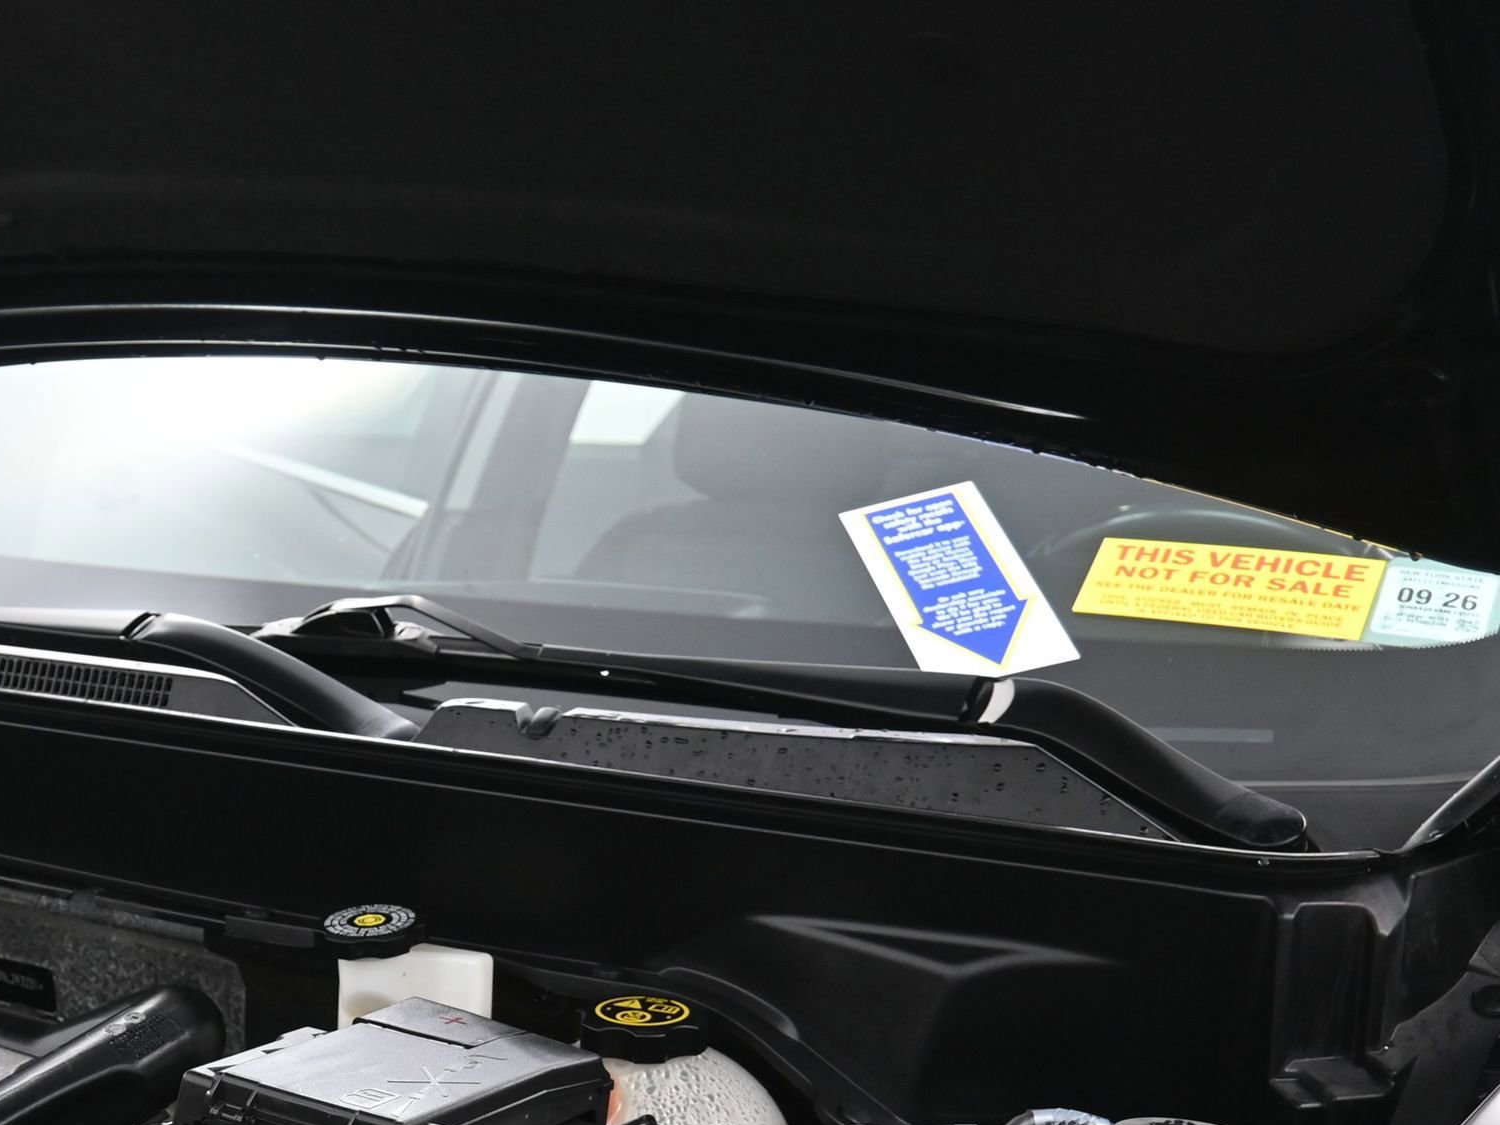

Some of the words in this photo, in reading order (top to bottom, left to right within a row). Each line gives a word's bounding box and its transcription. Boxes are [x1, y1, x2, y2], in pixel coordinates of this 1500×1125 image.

[1117, 545, 1195, 566] THIS
[1210, 551, 1370, 582] VEHICLE
[1115, 565, 1179, 580] NOT
[1189, 570, 1255, 588] FOR
[1266, 577, 1354, 599] SALE
[1127, 583, 1154, 591] THE
[1159, 586, 1217, 597] DEALER
[1222, 591, 1253, 600] FOR
[1257, 595, 1317, 607] RESALE
[1320, 601, 1362, 612] DATE
[1397, 587, 1432, 605] 09
[1442, 592, 1478, 611] 26
